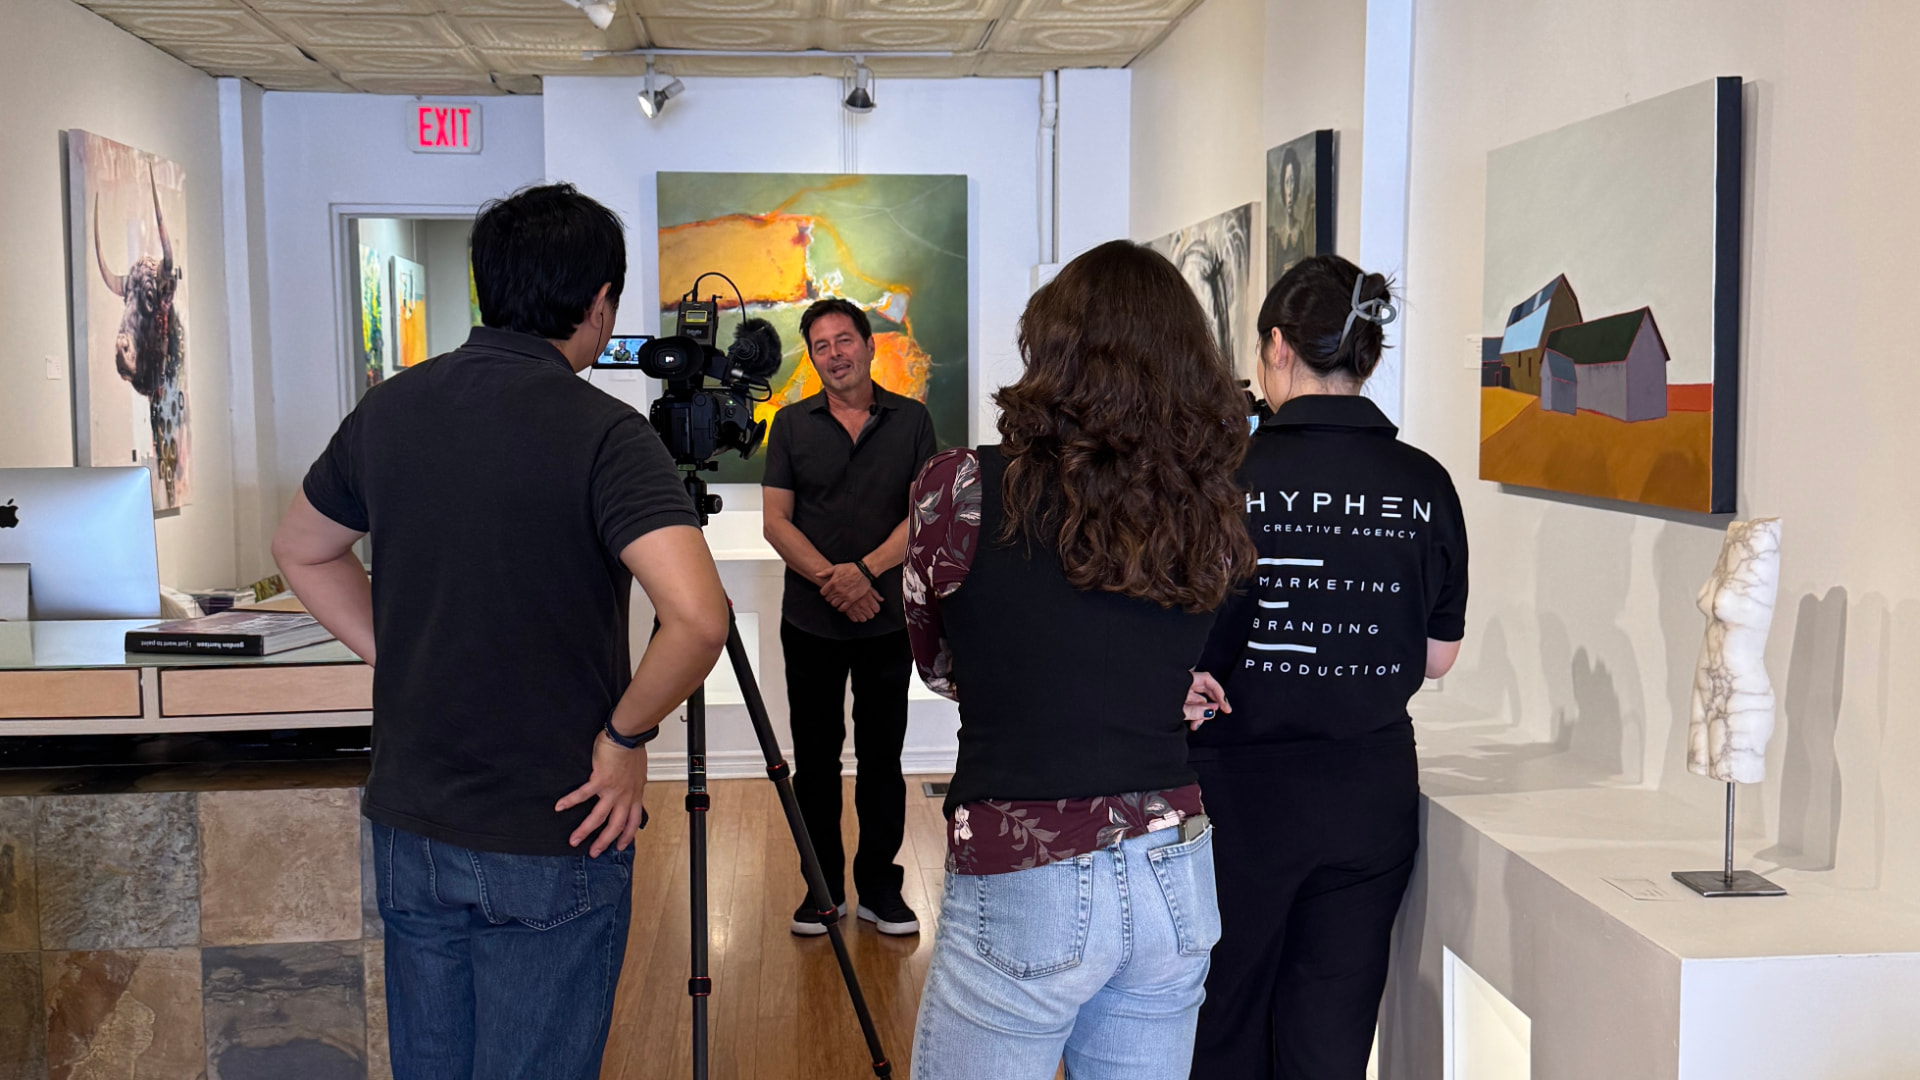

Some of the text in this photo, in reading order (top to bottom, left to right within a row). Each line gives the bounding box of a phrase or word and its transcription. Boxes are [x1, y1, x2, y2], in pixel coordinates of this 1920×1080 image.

[418, 107, 471, 147] EXIT
[1245, 491, 1431, 523] HYPHEN
[1263, 524, 1416, 540] CREATIVE AGENCY
[1259, 576, 1401, 593] MARKETING
[1252, 617, 1379, 635] BRANDING
[222, 641, 244, 649] gordon
[1245, 658, 1401, 677] PRODUCTION
